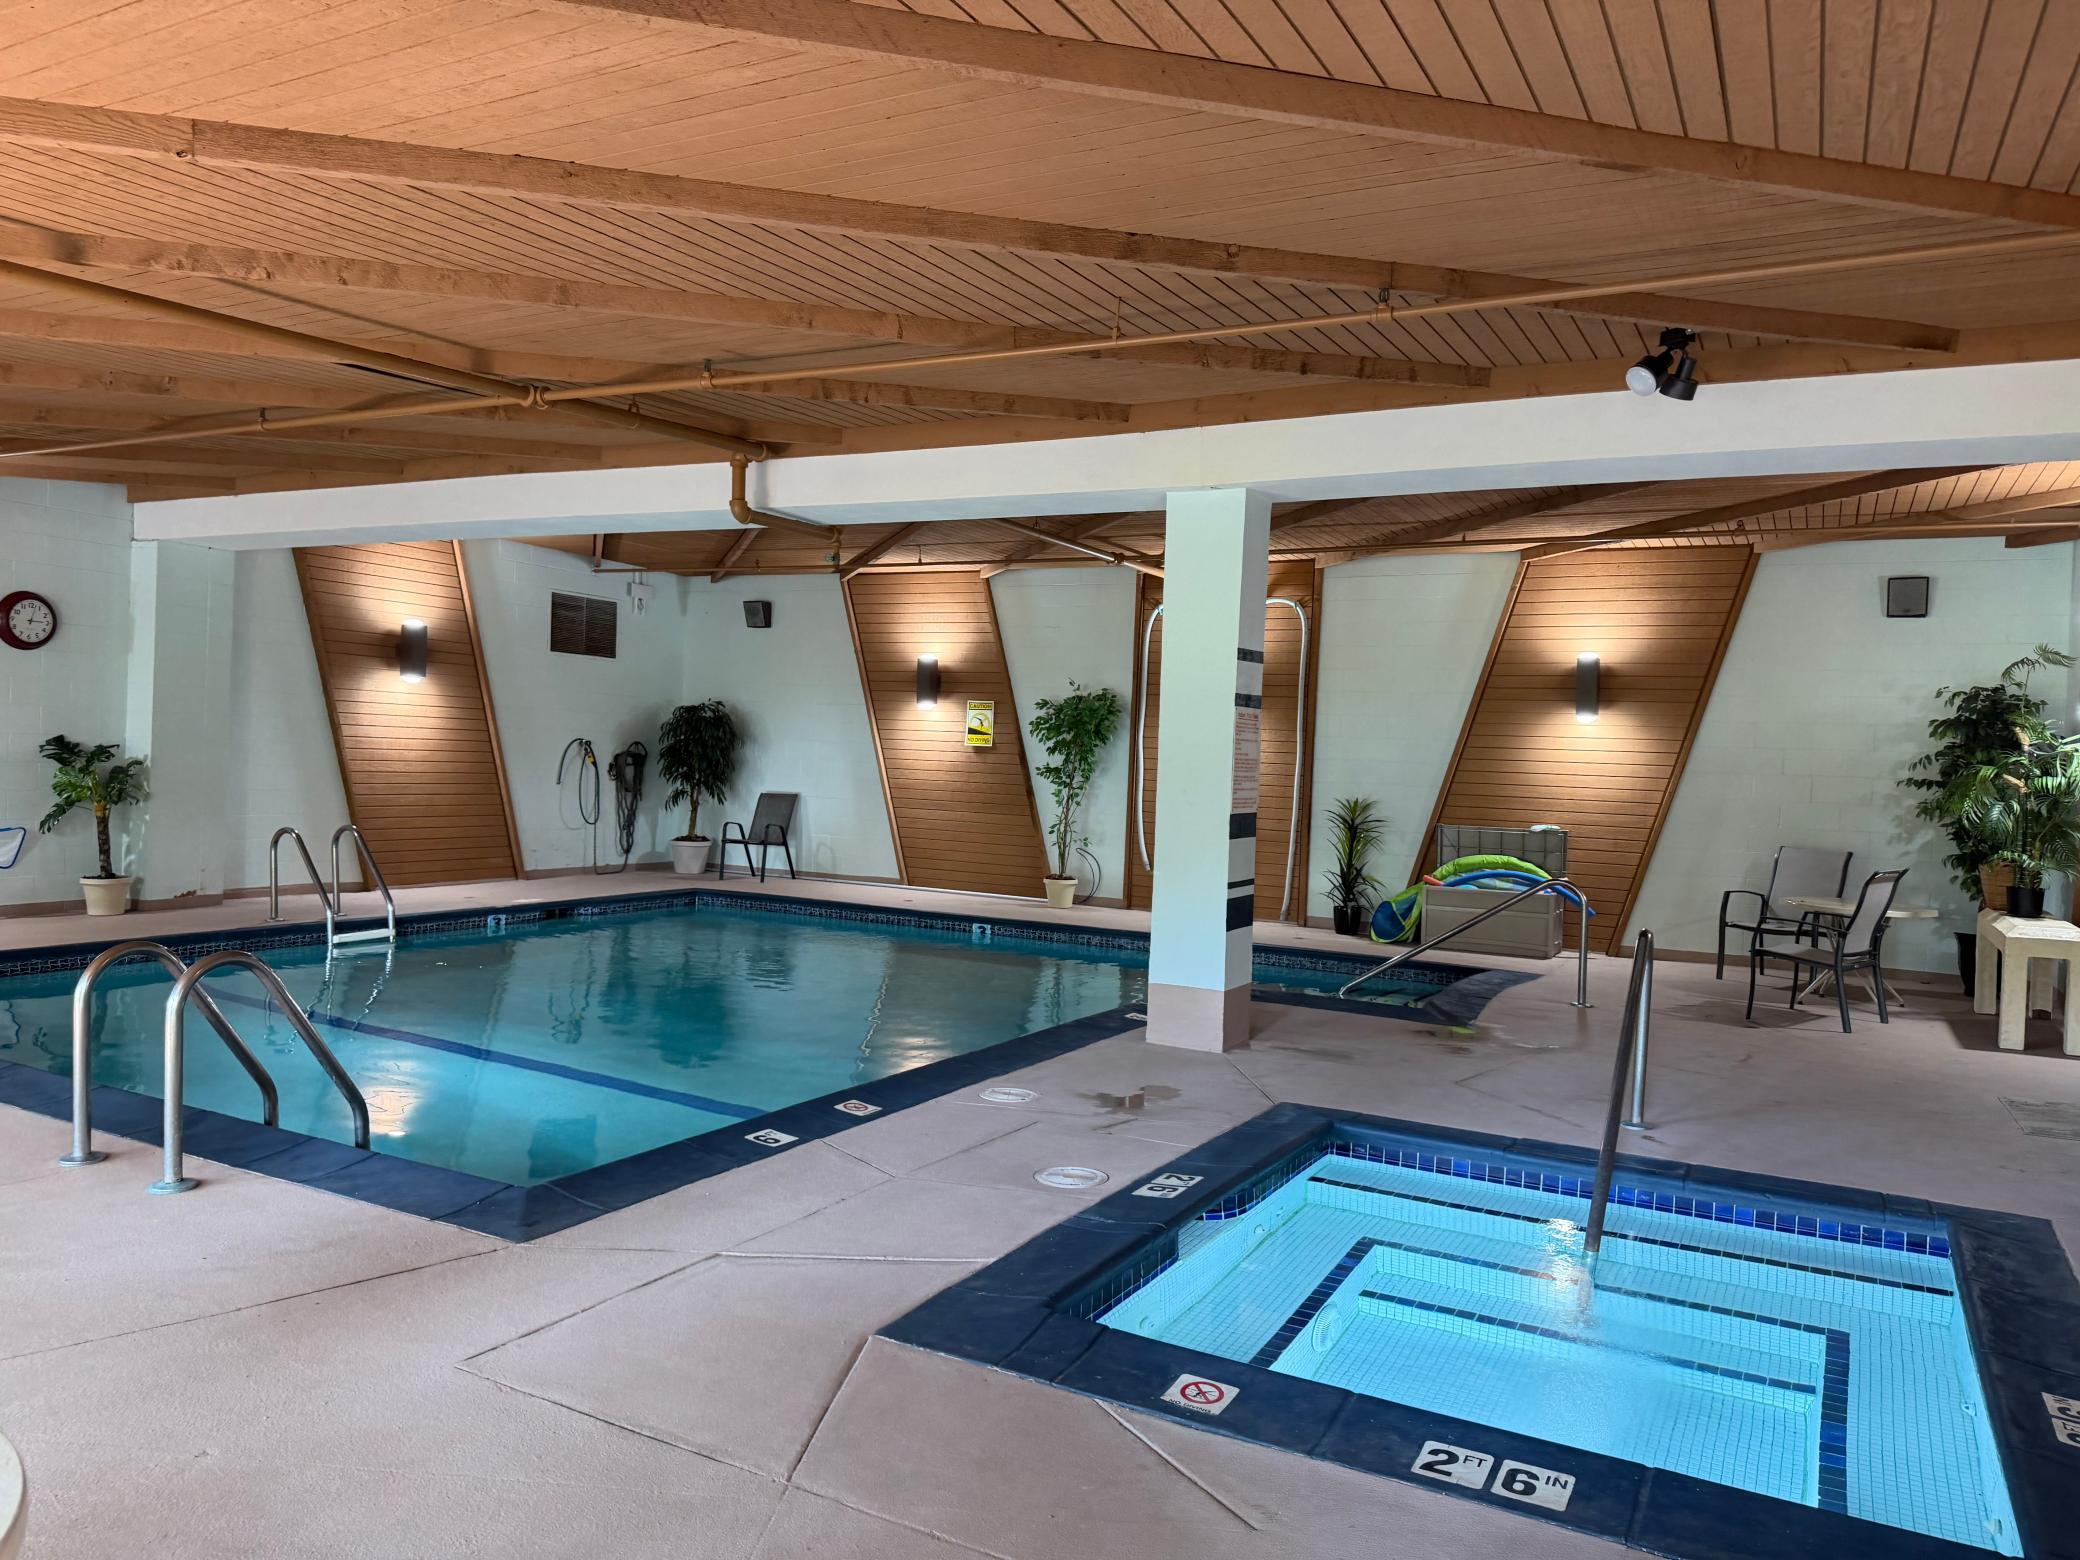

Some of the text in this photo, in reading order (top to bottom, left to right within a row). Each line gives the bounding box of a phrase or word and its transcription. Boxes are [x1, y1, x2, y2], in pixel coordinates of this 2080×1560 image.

[753, 1135, 781, 1144] 6
[1163, 1174, 1196, 1182] 2
[1184, 1402, 1213, 1414] DIVING
[1419, 1449, 1568, 1496] 2 FT 6 IN
